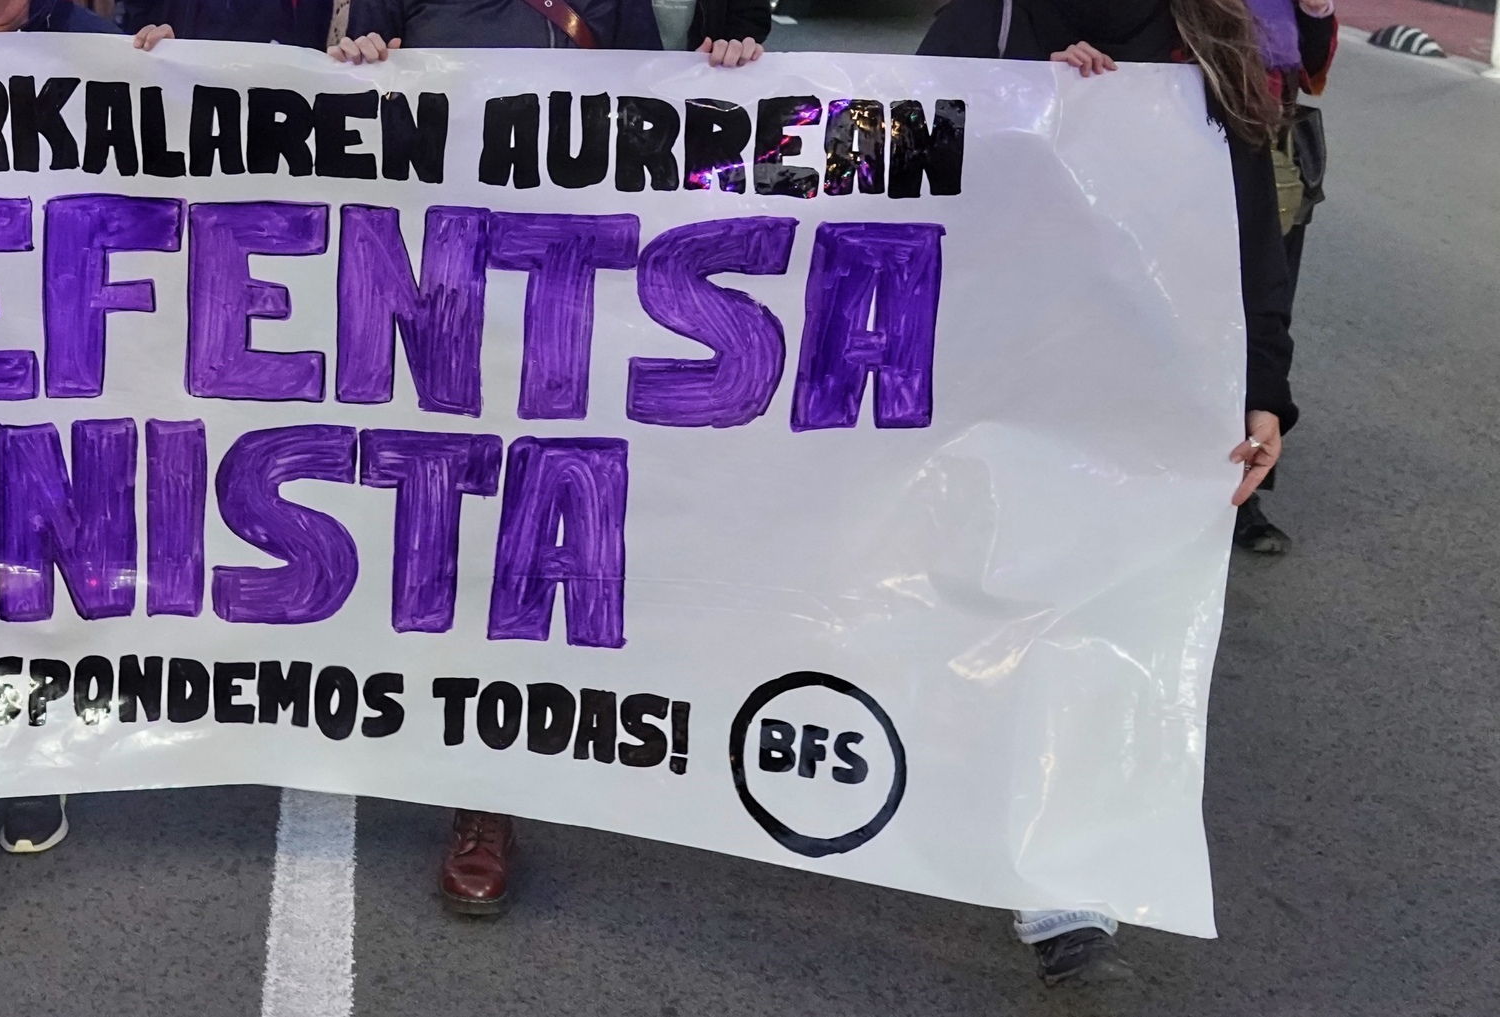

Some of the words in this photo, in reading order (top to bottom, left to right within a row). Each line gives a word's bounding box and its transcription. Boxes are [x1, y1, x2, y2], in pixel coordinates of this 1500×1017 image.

[478, 91, 966, 200] AURREAN
[432, 677, 691, 776] TODAS!
[758, 718, 870, 785] BFS
